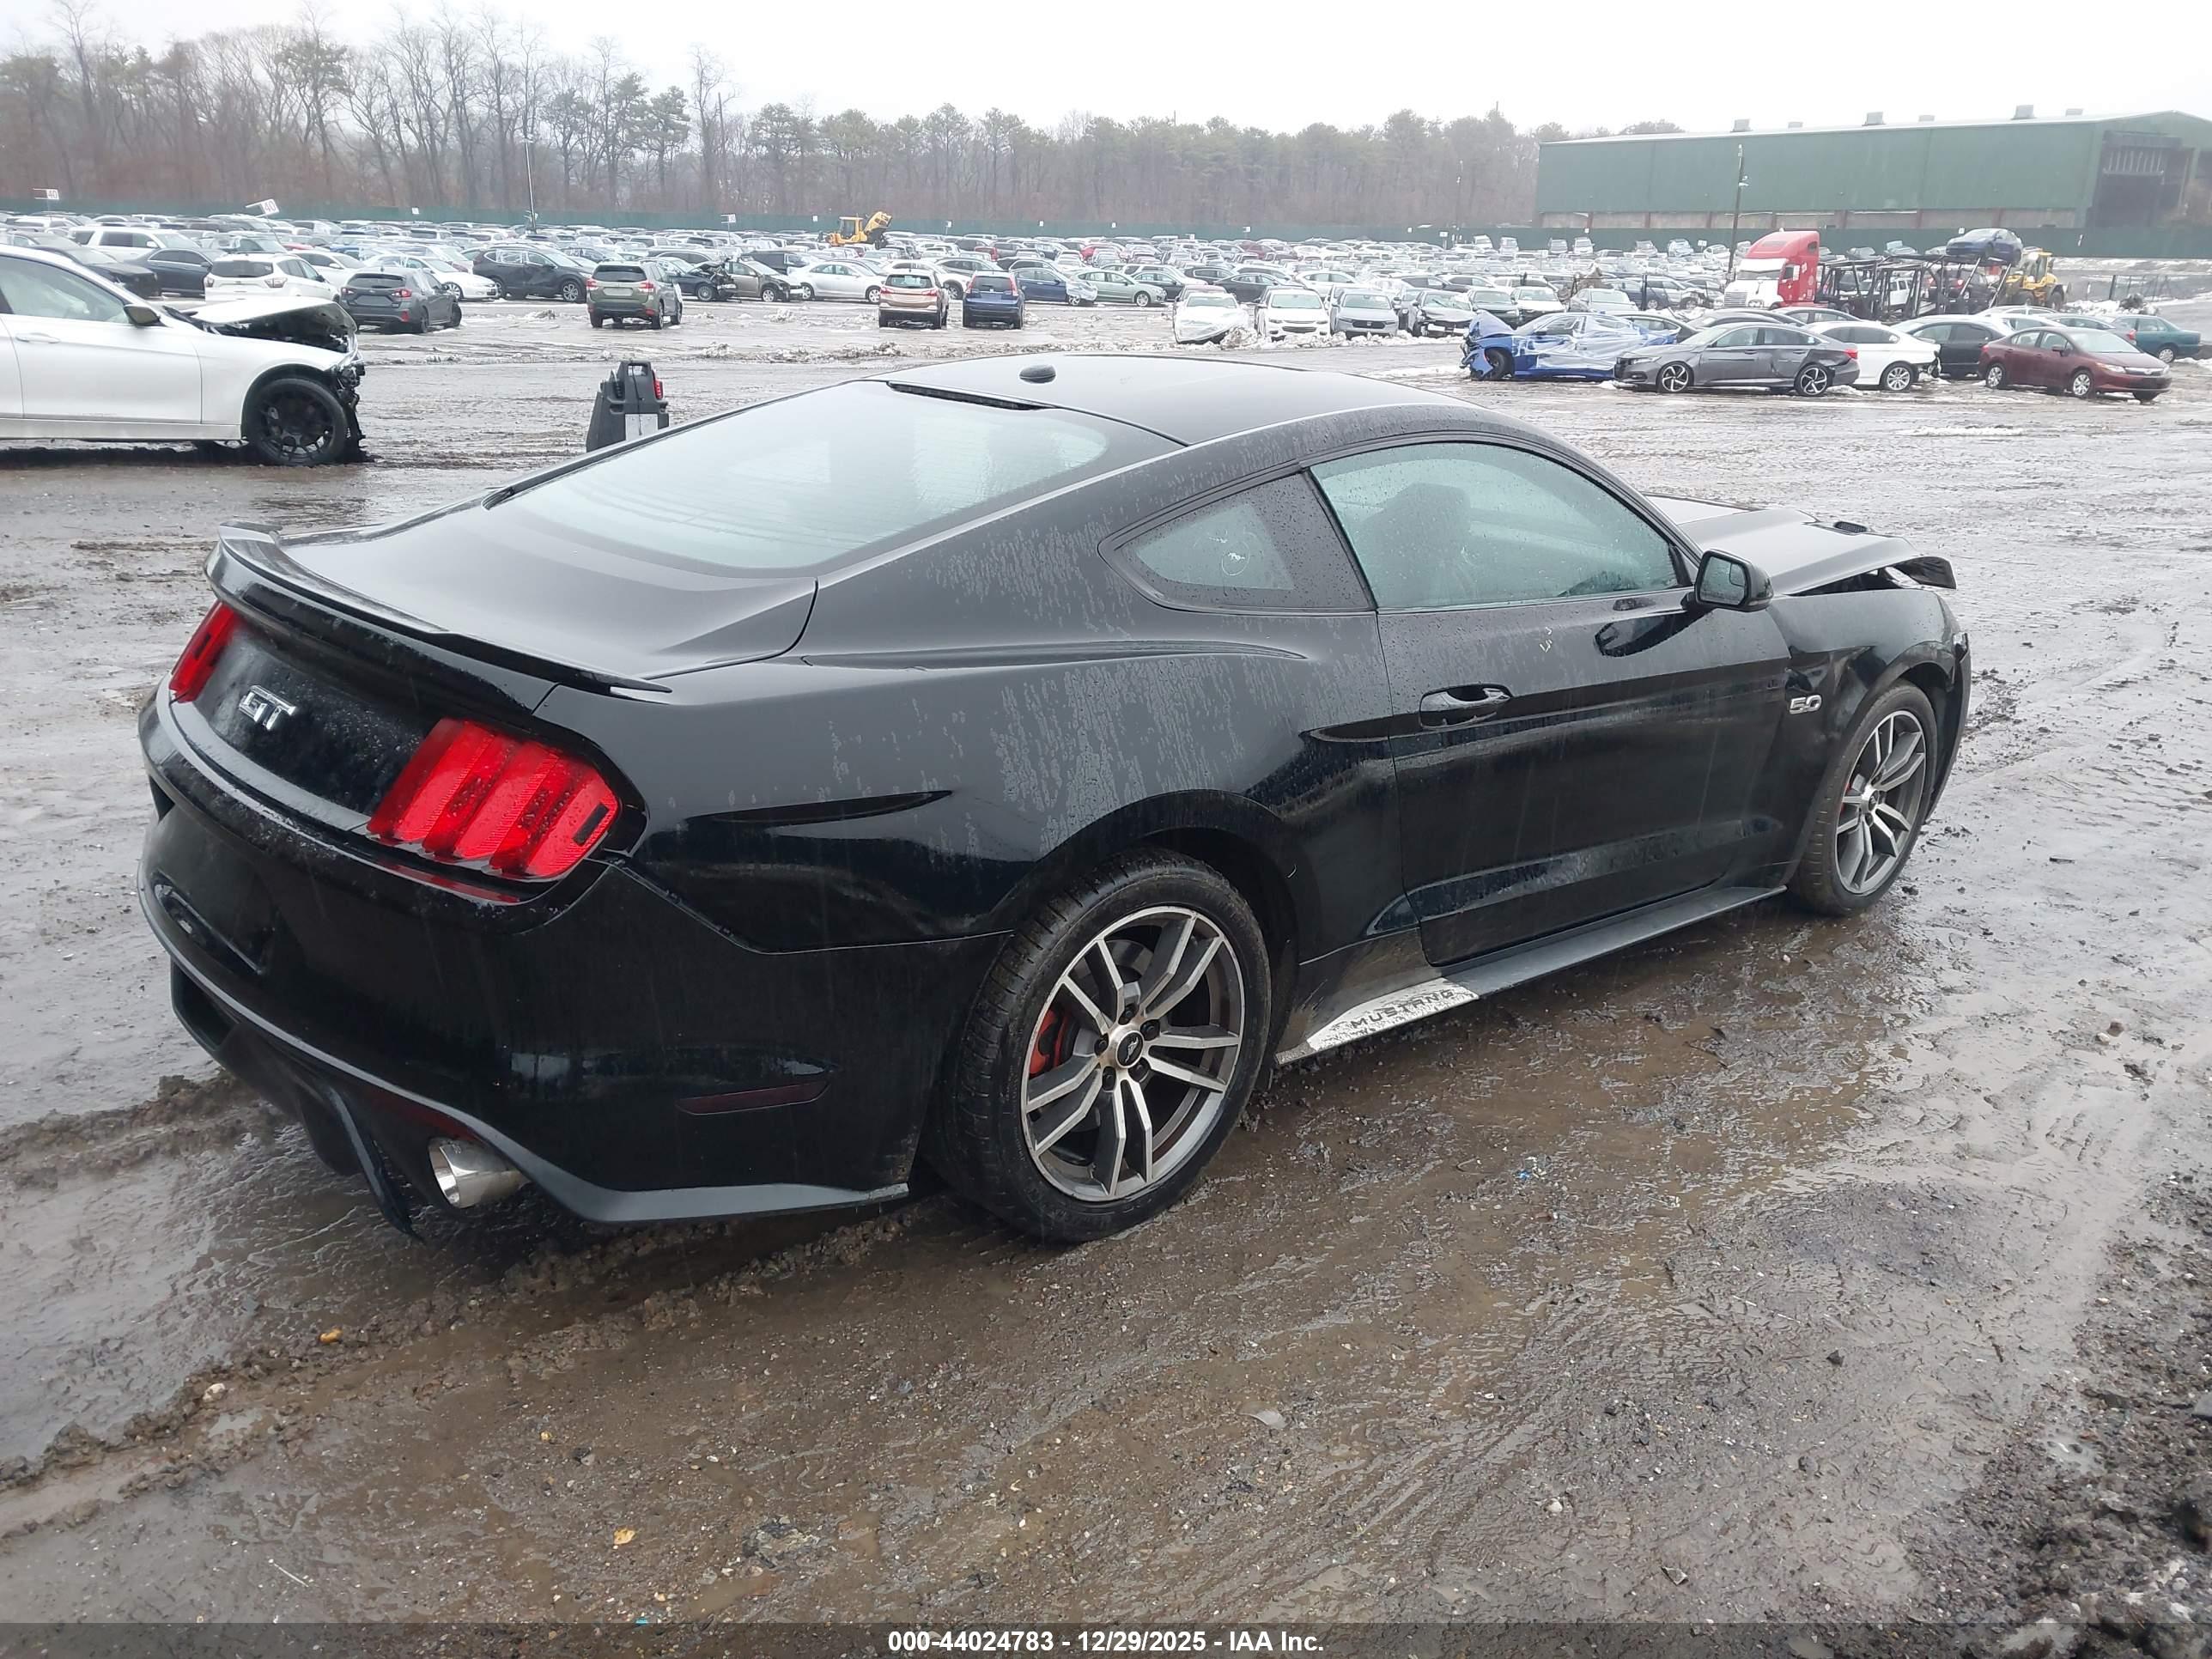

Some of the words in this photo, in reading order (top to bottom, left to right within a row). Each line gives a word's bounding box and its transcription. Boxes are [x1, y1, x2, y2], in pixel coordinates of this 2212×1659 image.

[47, 189, 58, 198] 40
[264, 199, 276, 212] 40
[239, 684, 296, 730] GT
[1350, 989, 1454, 1029] MUSTANG
